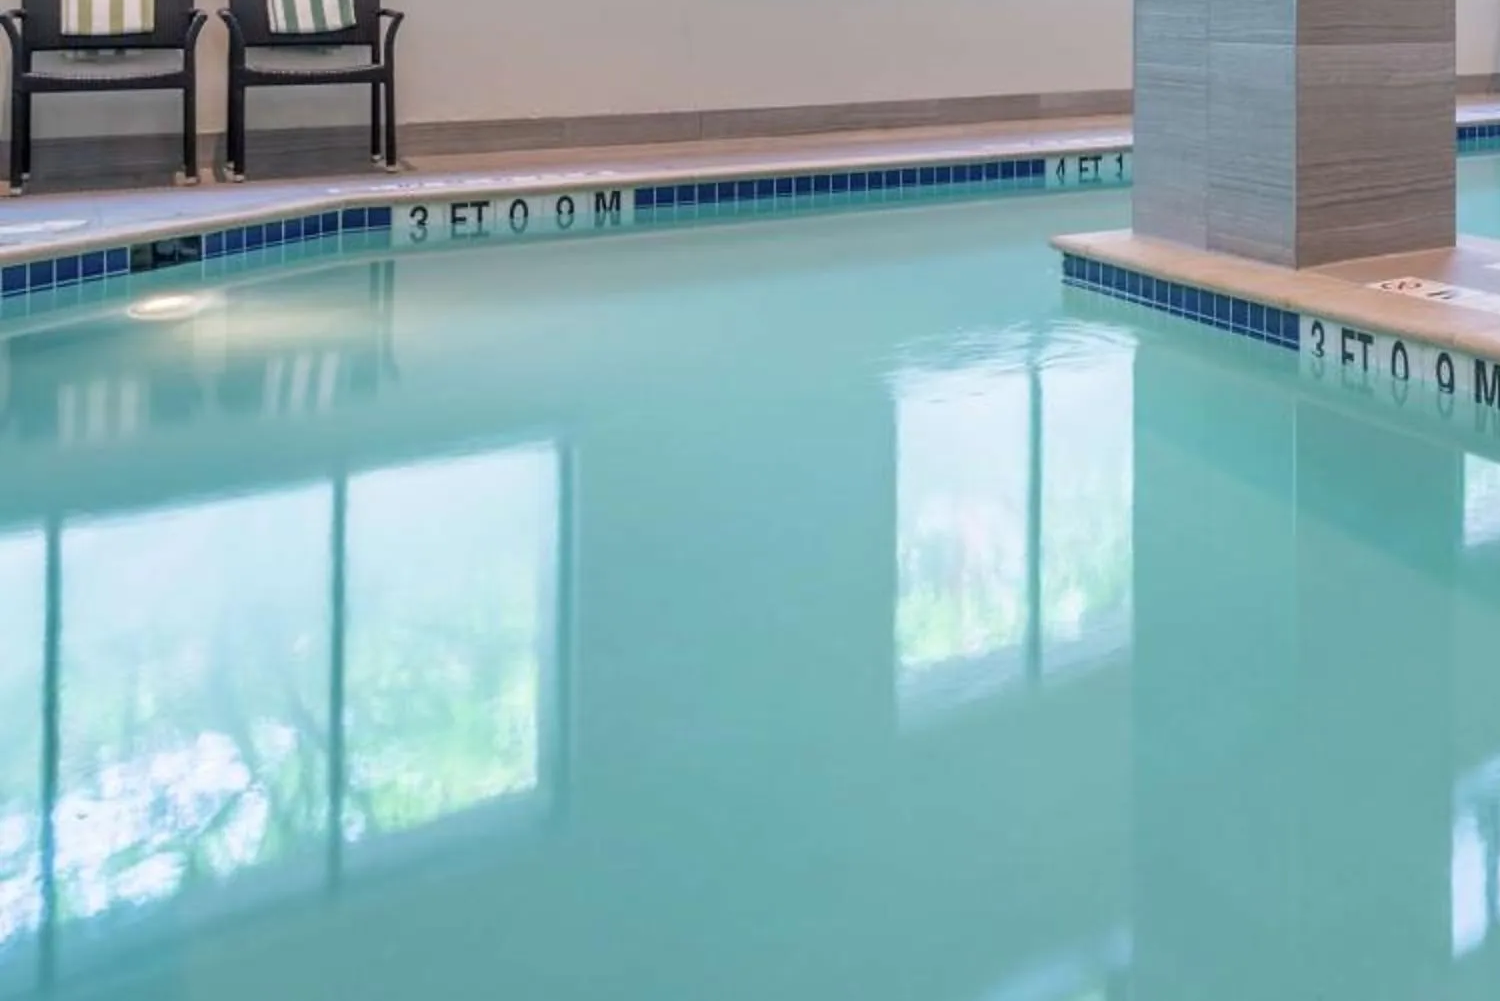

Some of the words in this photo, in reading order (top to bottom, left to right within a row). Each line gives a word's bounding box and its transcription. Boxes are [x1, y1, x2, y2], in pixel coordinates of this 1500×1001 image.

[1079, 155, 1103, 175] FT
[410, 205, 429, 226] 3
[451, 201, 490, 225] FT
[595, 190, 621, 212] M
[1311, 320, 1325, 358] 3
[1341, 327, 1374, 373] FT
[1391, 340, 1409, 381] 0
